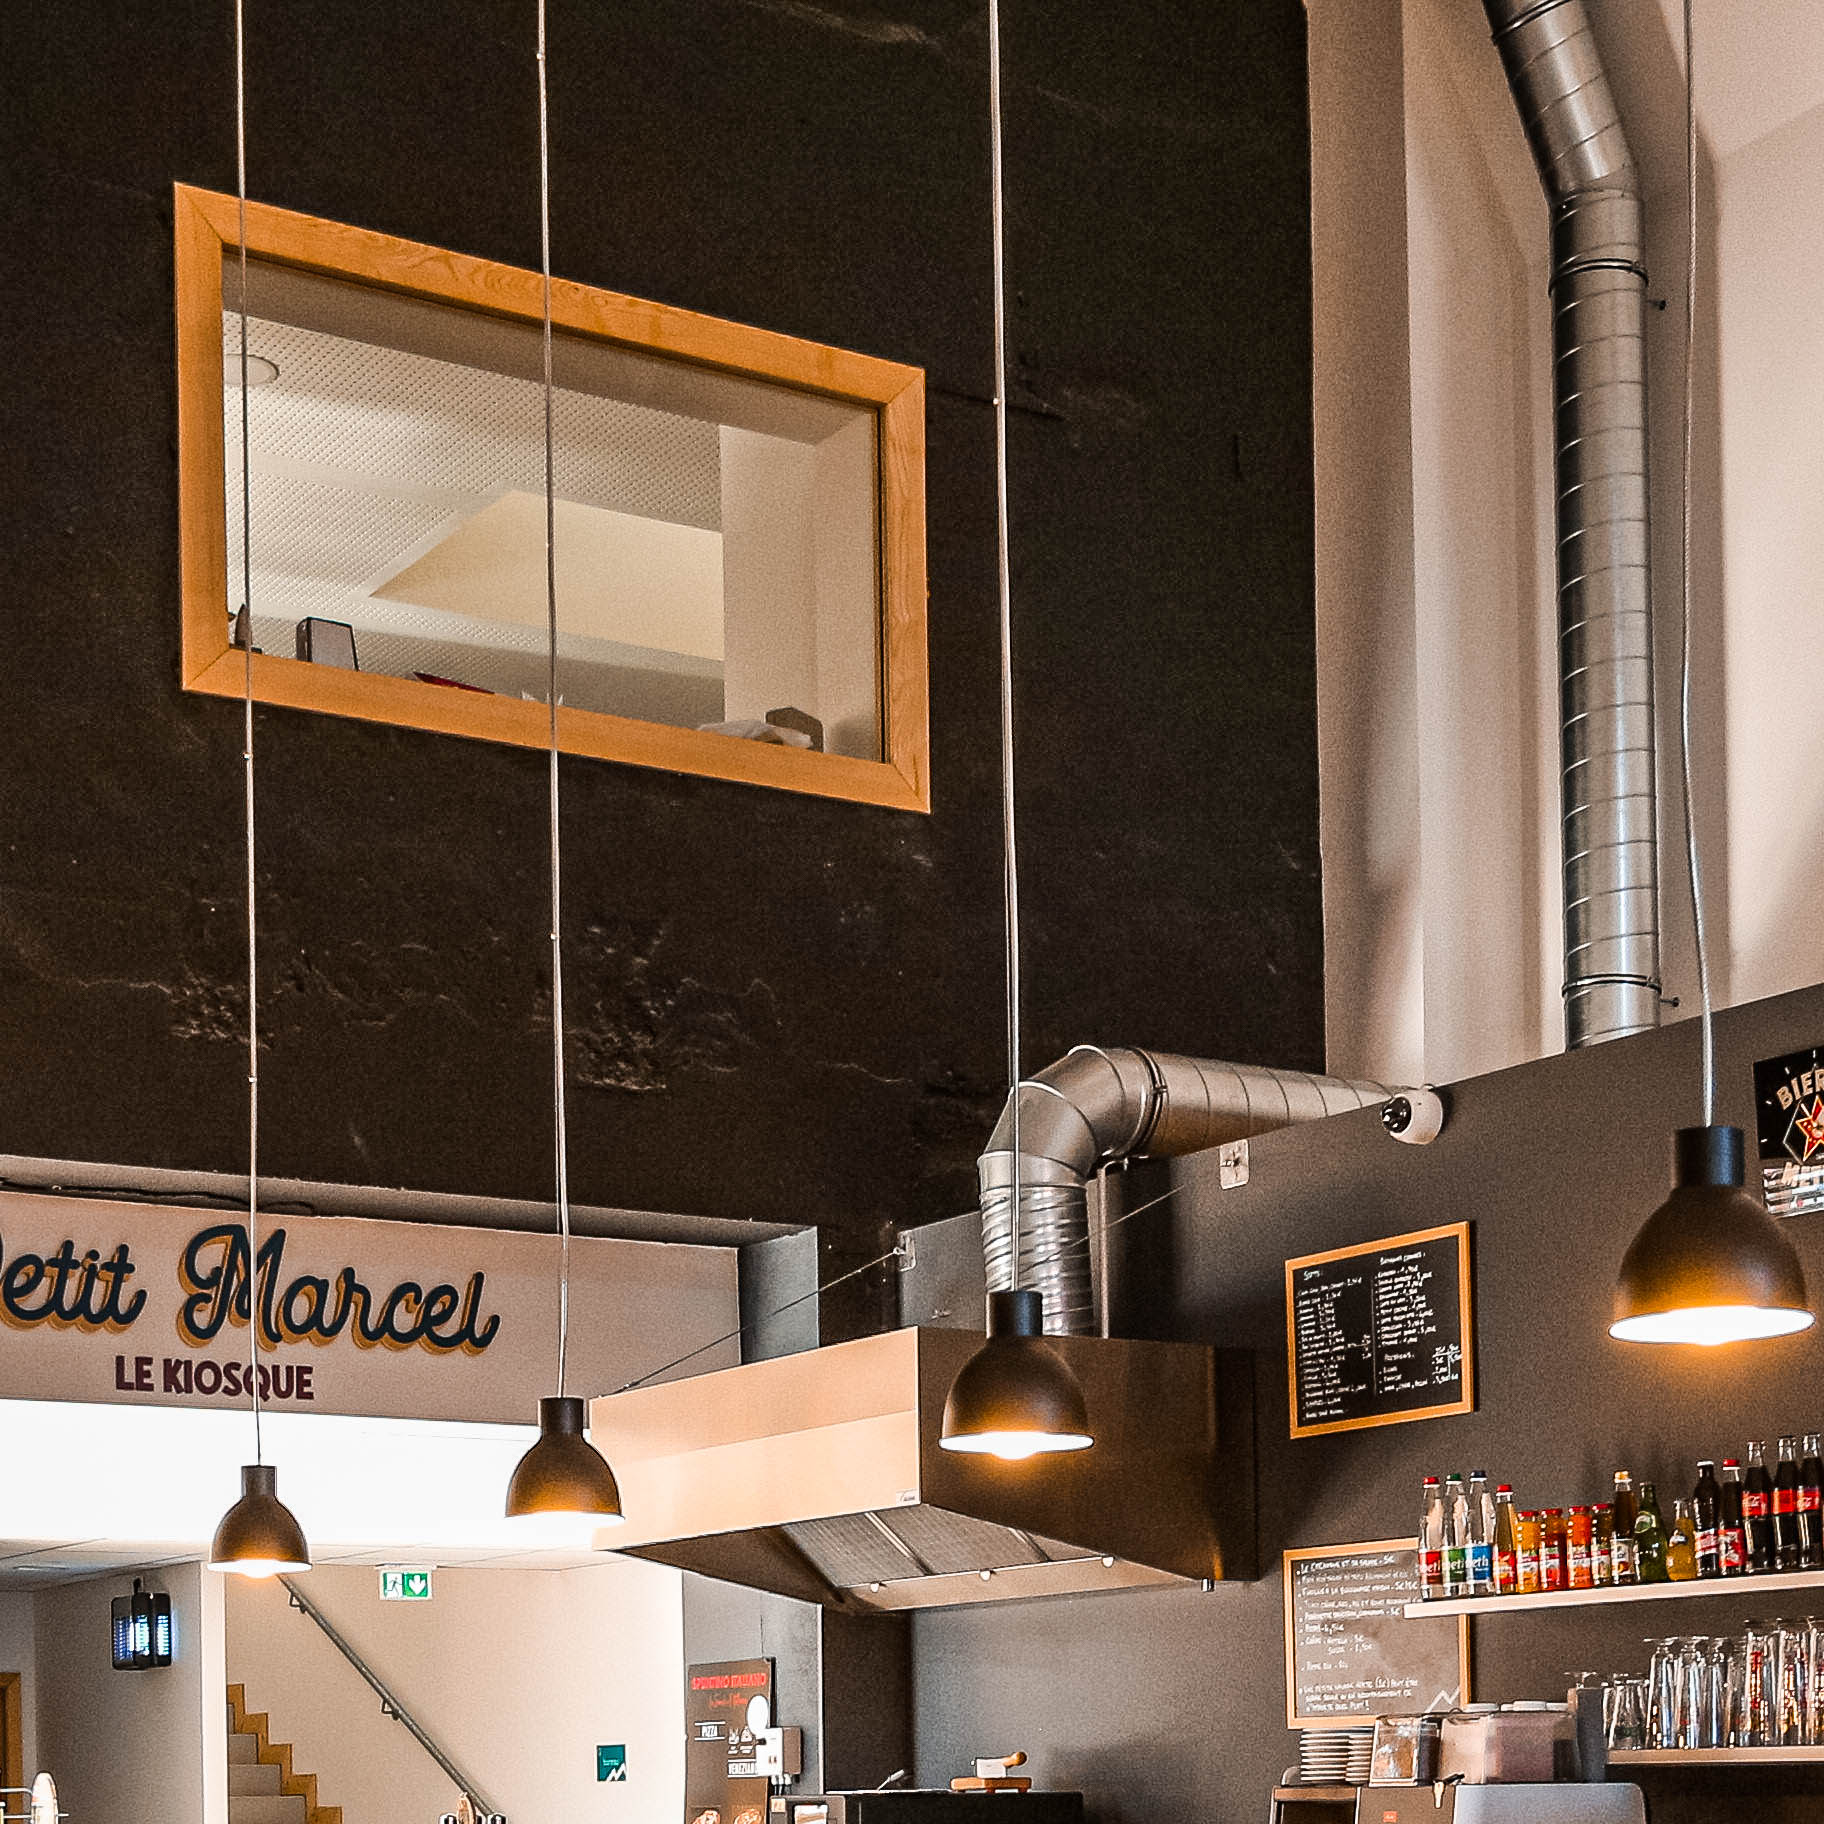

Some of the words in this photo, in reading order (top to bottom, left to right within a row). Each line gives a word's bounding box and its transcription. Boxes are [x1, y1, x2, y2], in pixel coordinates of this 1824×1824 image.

[176, 1222, 499, 1356] Marcel
[115, 1355, 153, 1394] LE
[164, 1358, 315, 1400] KIOSQUE
